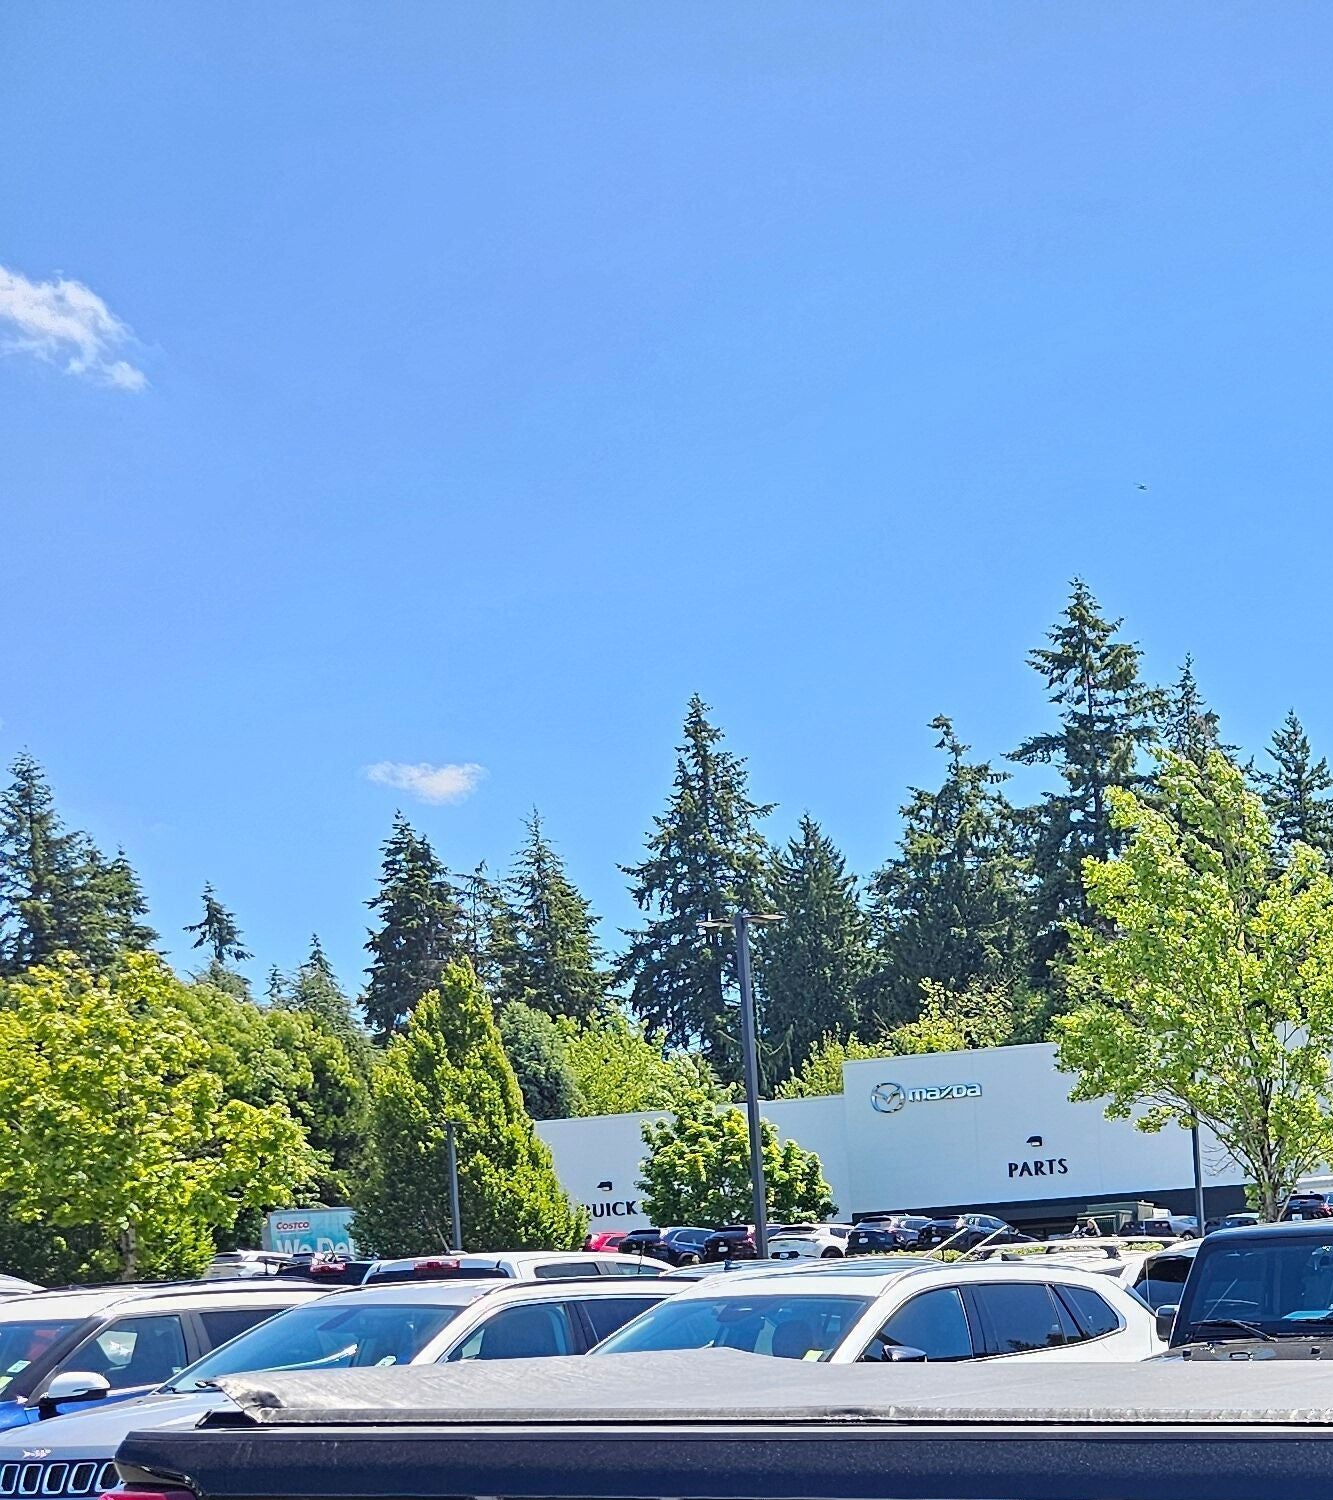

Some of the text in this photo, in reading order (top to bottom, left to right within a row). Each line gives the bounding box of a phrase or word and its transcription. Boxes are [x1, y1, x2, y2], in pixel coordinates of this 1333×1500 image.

[1008, 1158, 1069, 1178] PARTS
[585, 1201, 639, 1218] UICK
[276, 1221, 310, 1230] COSTCO
